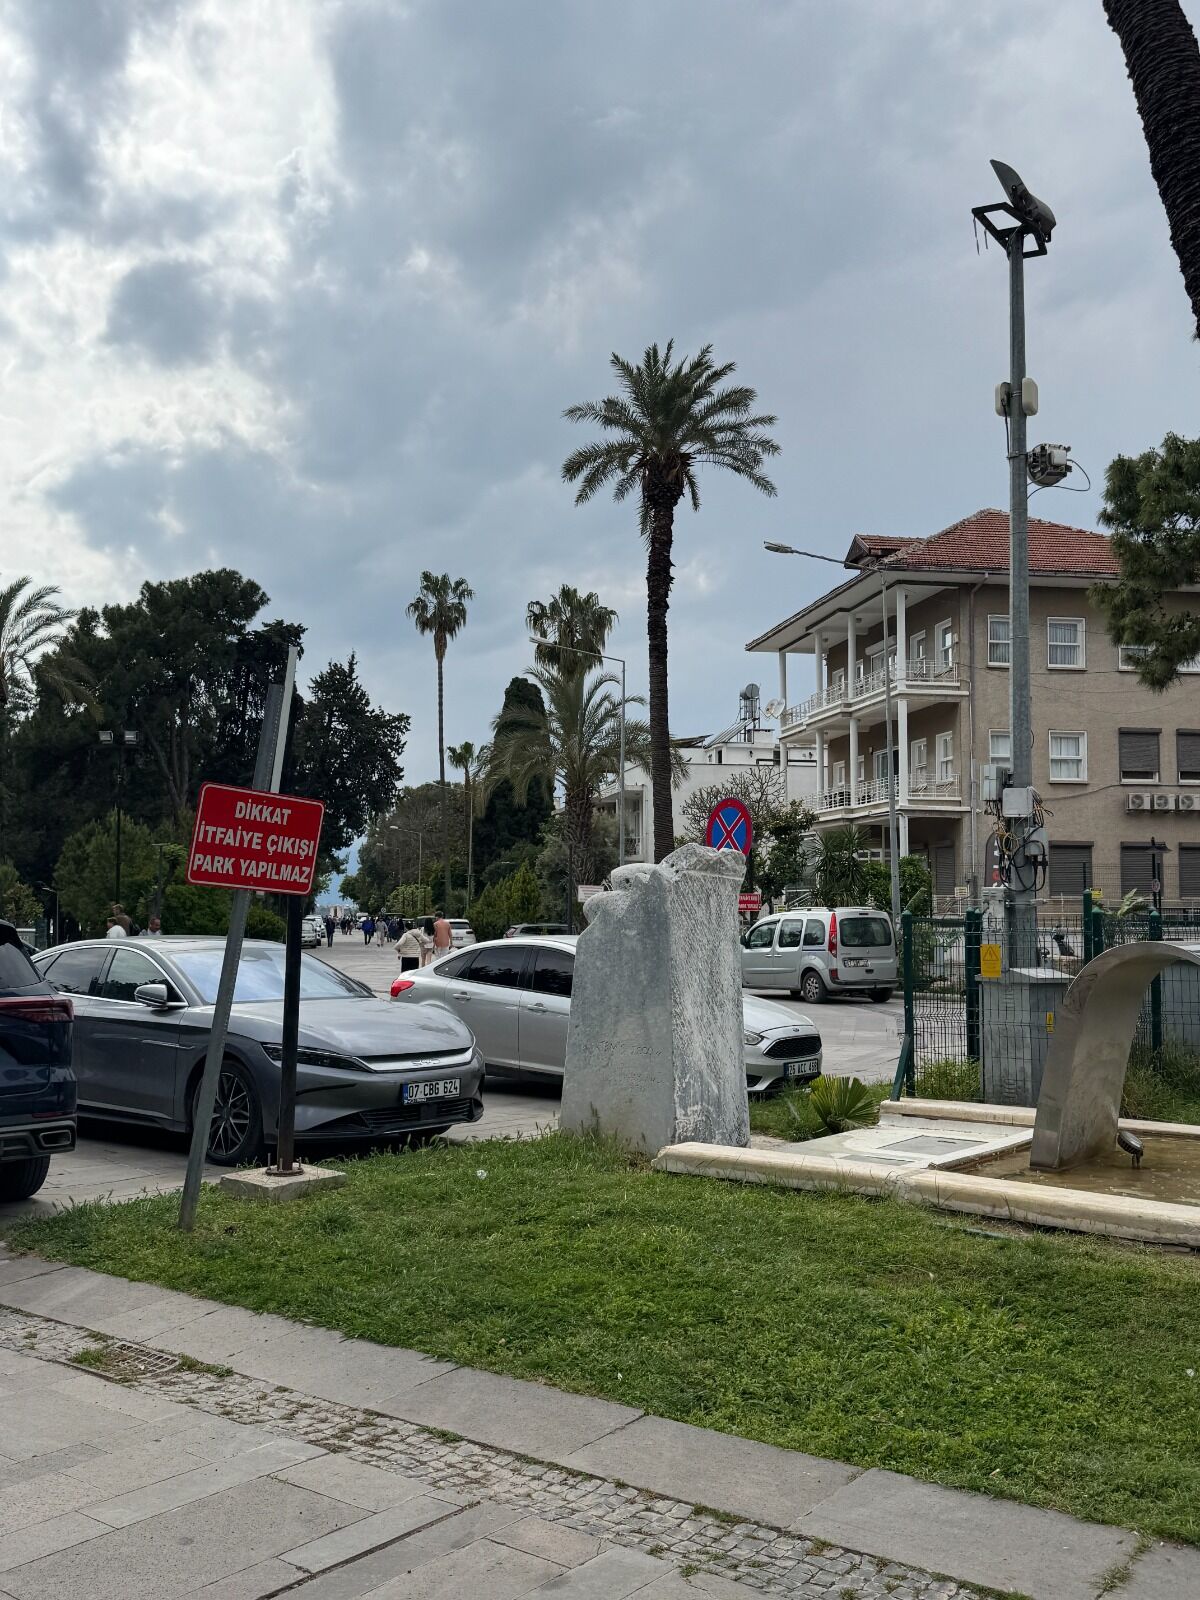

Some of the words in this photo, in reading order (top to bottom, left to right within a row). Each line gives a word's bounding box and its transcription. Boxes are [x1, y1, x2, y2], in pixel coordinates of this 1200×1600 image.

[235, 799, 292, 825] DİKKAT
[198, 820, 263, 850] İTFAİYE
[266, 834, 314, 860] ÇIKIŞI
[193, 853, 235, 875] PARK
[240, 858, 311, 883] YAPILMAZ
[408, 1084, 420, 1098] 07
[423, 1082, 440, 1097] CBG
[443, 1080, 458, 1094] 624
